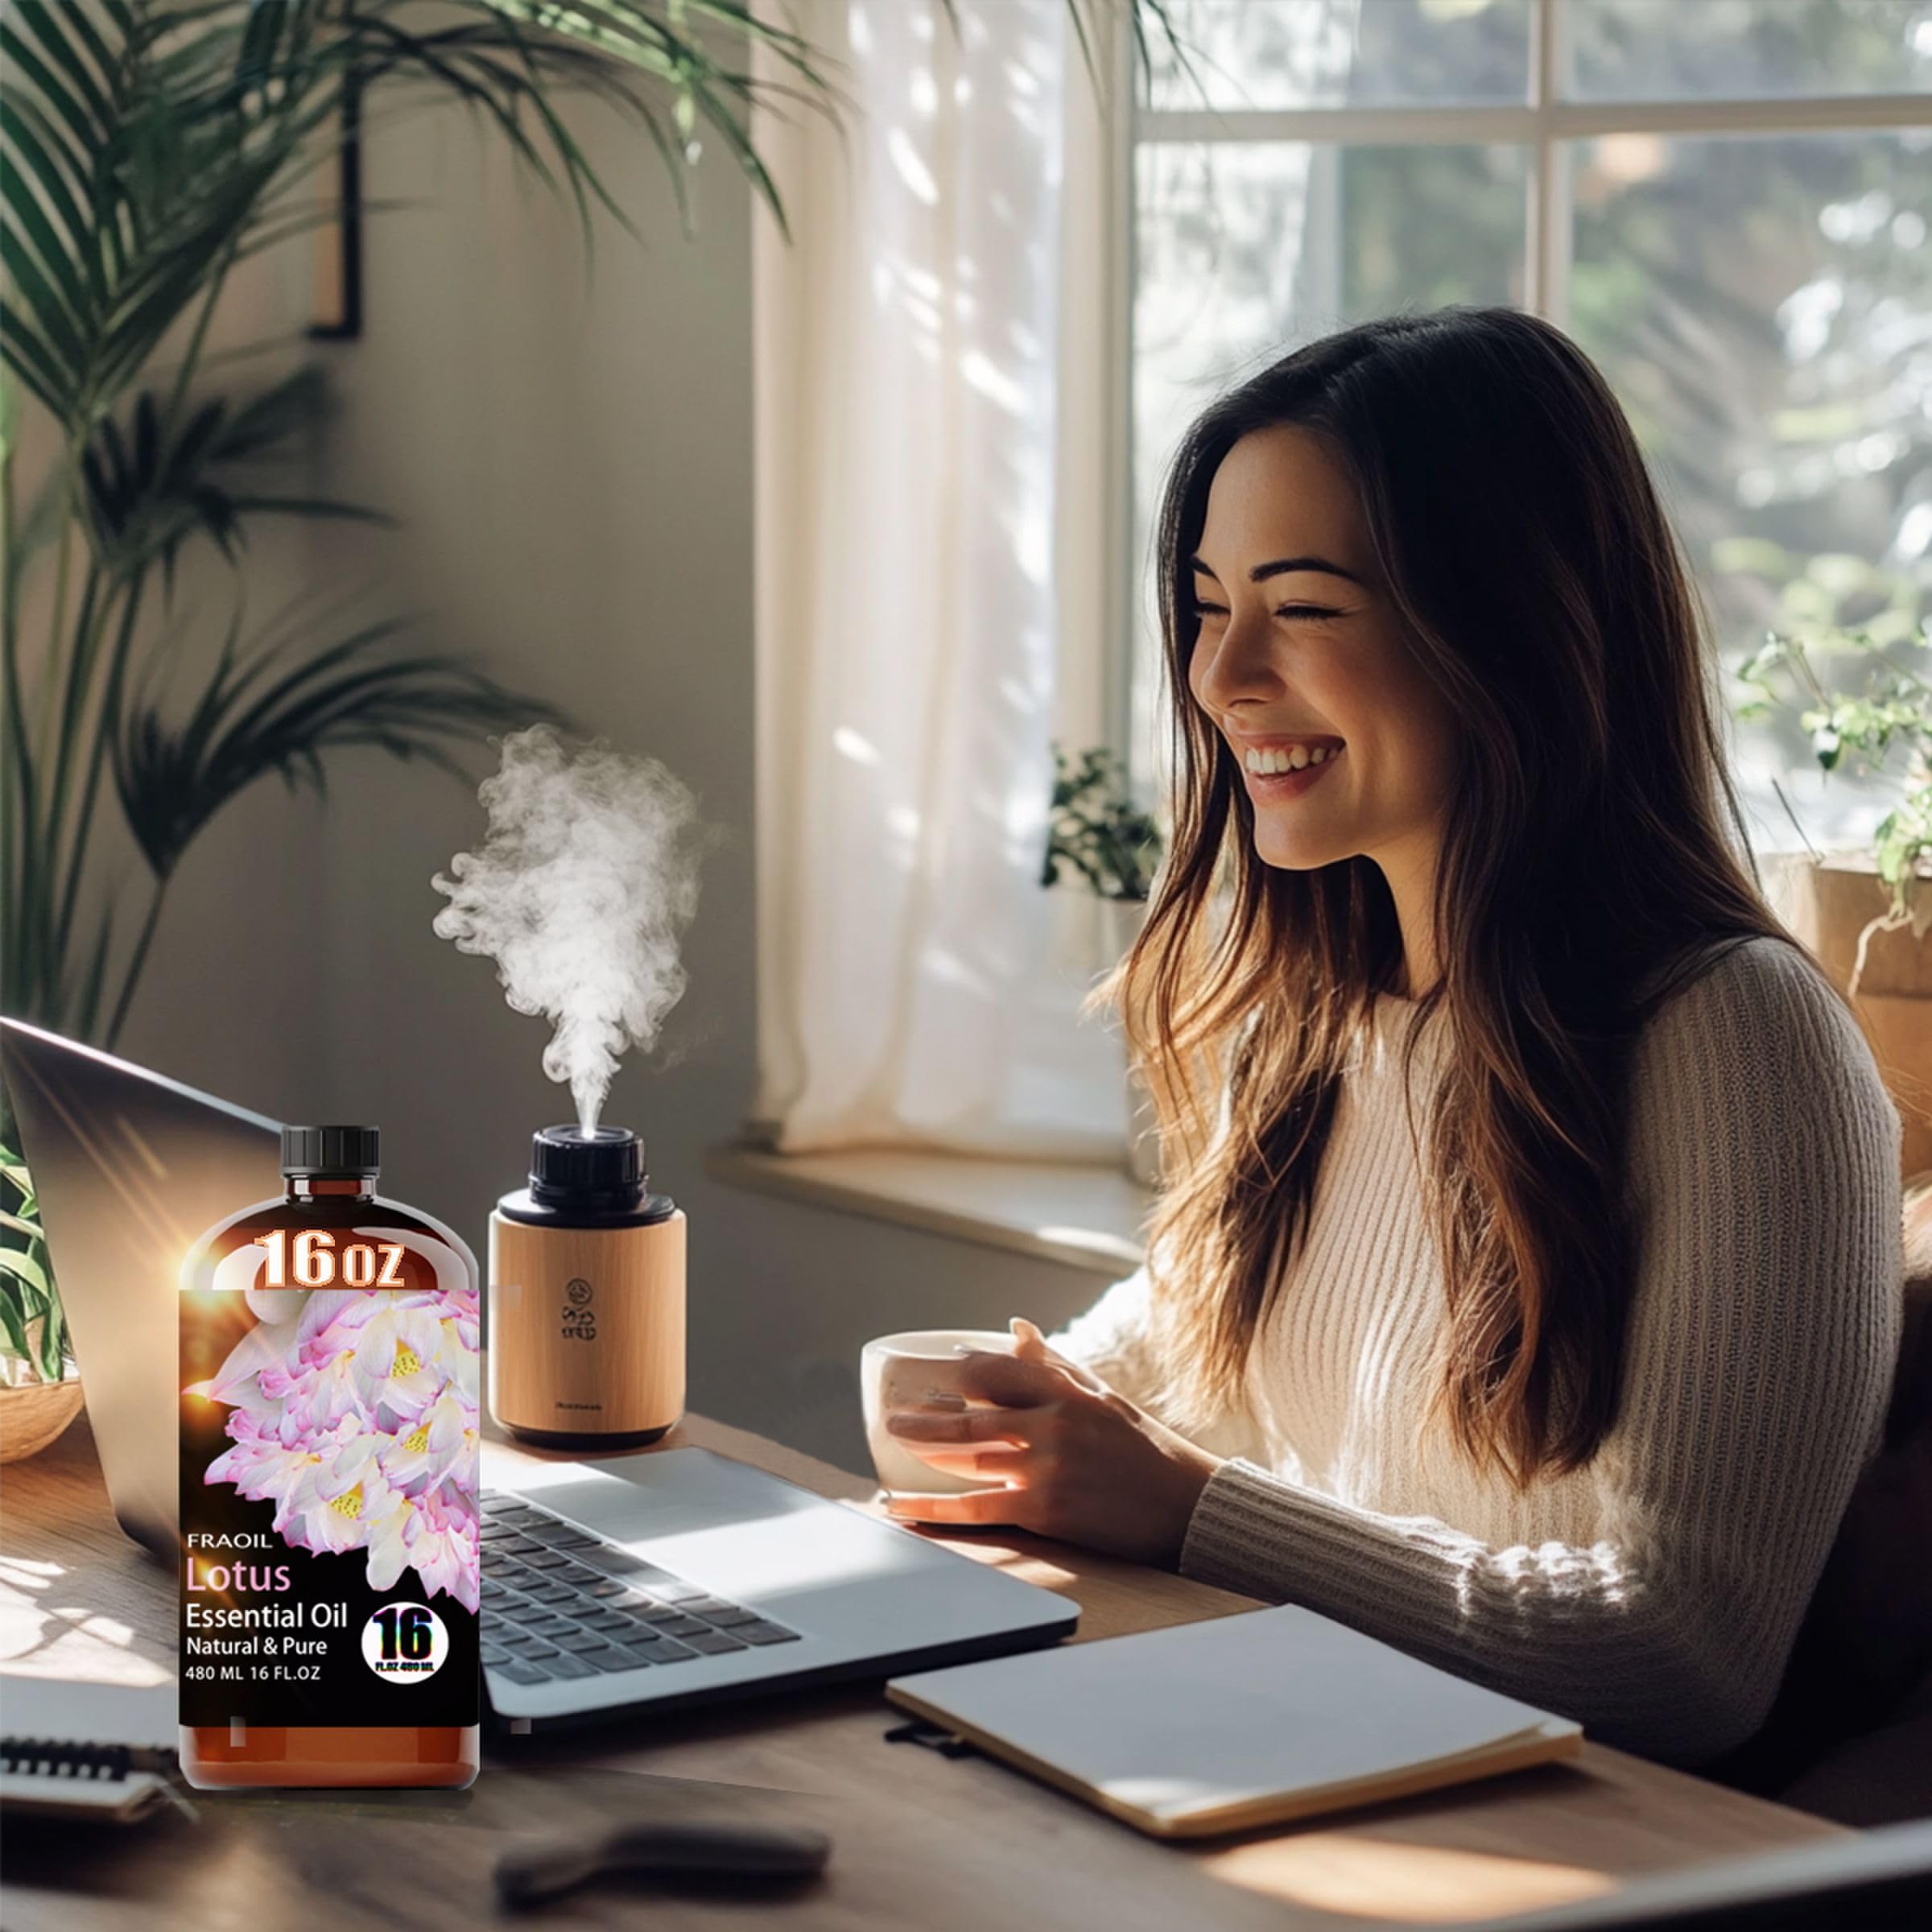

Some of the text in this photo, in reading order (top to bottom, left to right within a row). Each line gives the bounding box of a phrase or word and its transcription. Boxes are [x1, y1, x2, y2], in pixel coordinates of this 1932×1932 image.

[254, 1229, 336, 1287] 16
[187, 1533, 274, 1548] FRAOIL
[186, 1557, 291, 1592] Lotus
[186, 1602, 347, 1629] Essential Oil
[186, 1637, 328, 1655] Natural & Pure
[373, 1607, 433, 1660] 16
[185, 1666, 320, 1680] 480 ML 16 FL.OZ
